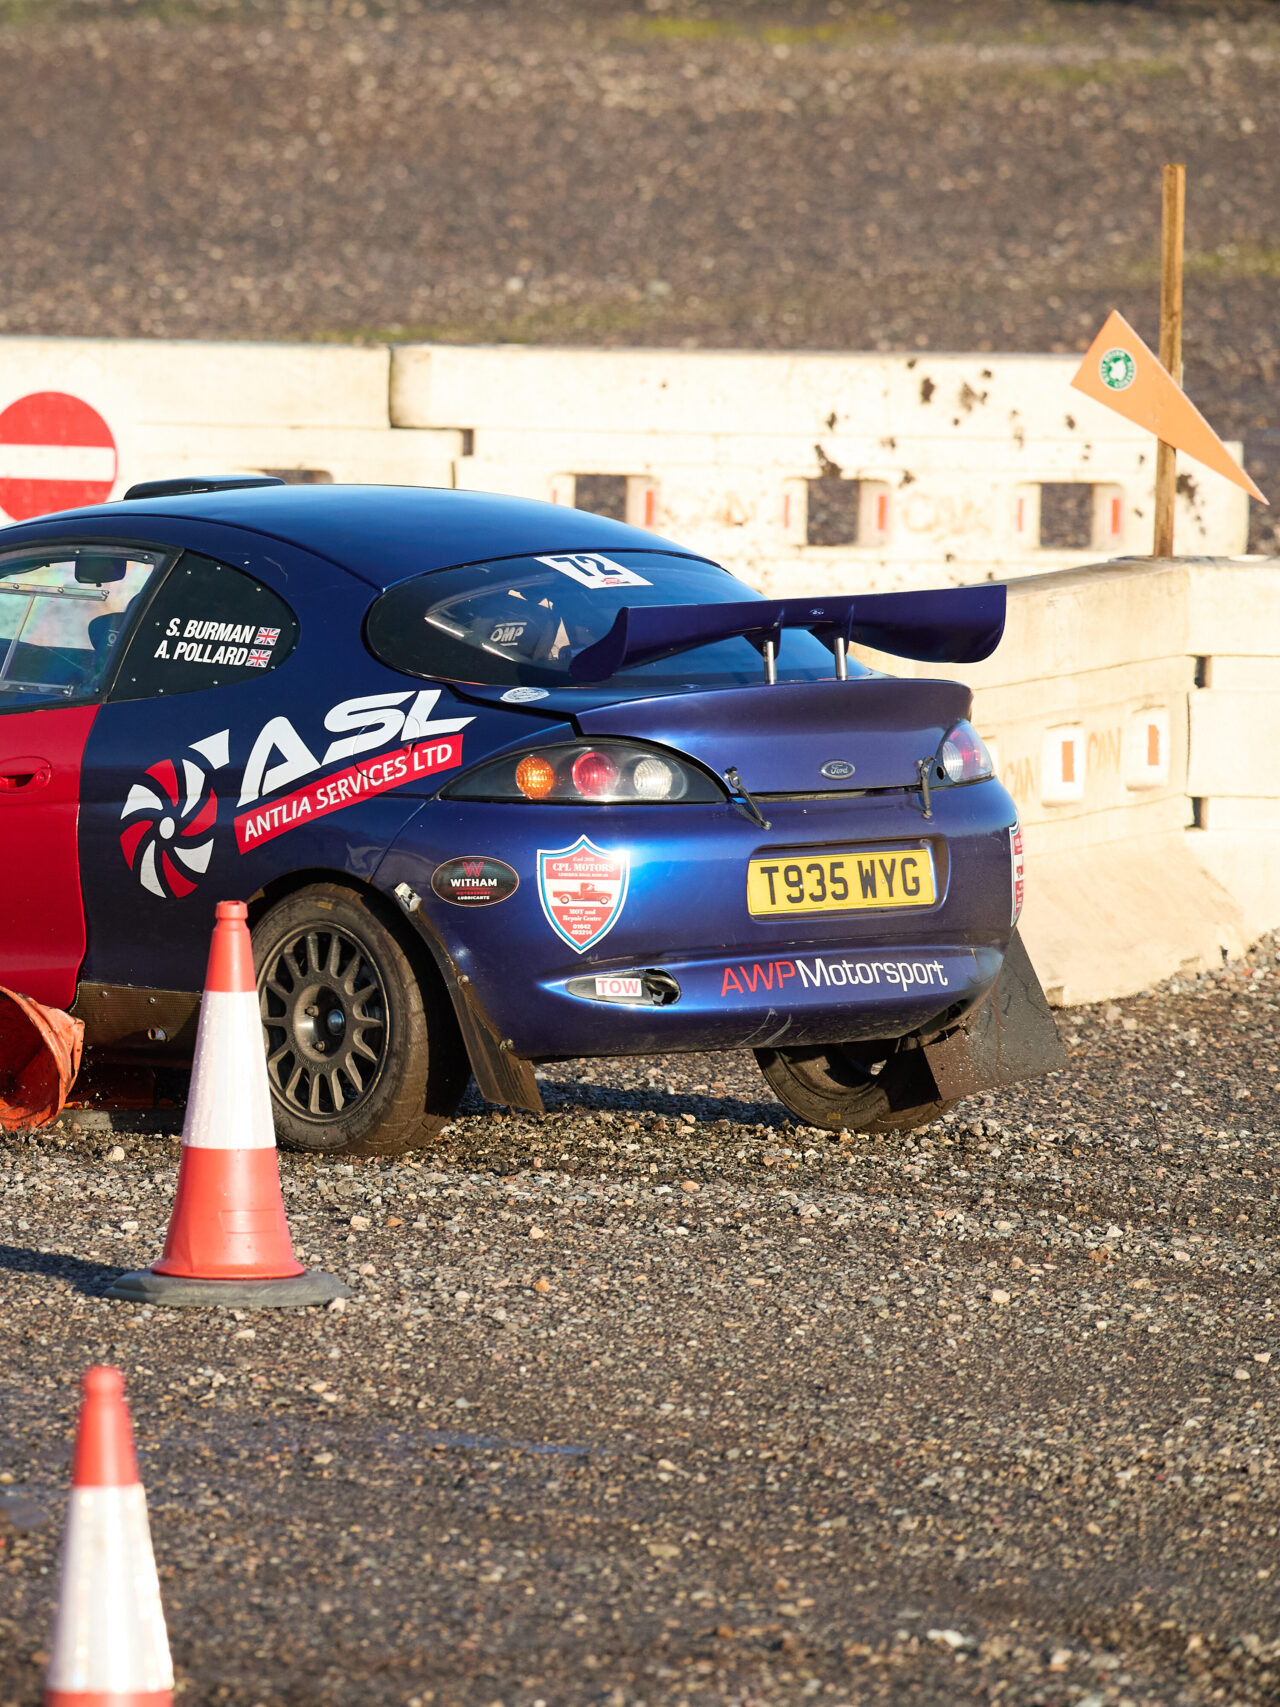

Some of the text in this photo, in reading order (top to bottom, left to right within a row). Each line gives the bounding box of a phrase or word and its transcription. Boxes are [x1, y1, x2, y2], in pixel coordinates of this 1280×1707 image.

[549, 556, 624, 577] 72
[166, 617, 256, 644] S. BURMAN
[490, 626, 524, 642] OMP
[153, 640, 248, 667] A. POLLARD
[236, 689, 478, 808] ASL
[244, 743, 453, 843] ANTLIA SERVICES LTD
[552, 863, 615, 873] CPL MOTORS
[450, 878, 498, 887] WITHAM
[760, 857, 920, 905] T935 WYG
[597, 980, 641, 994] TOW
